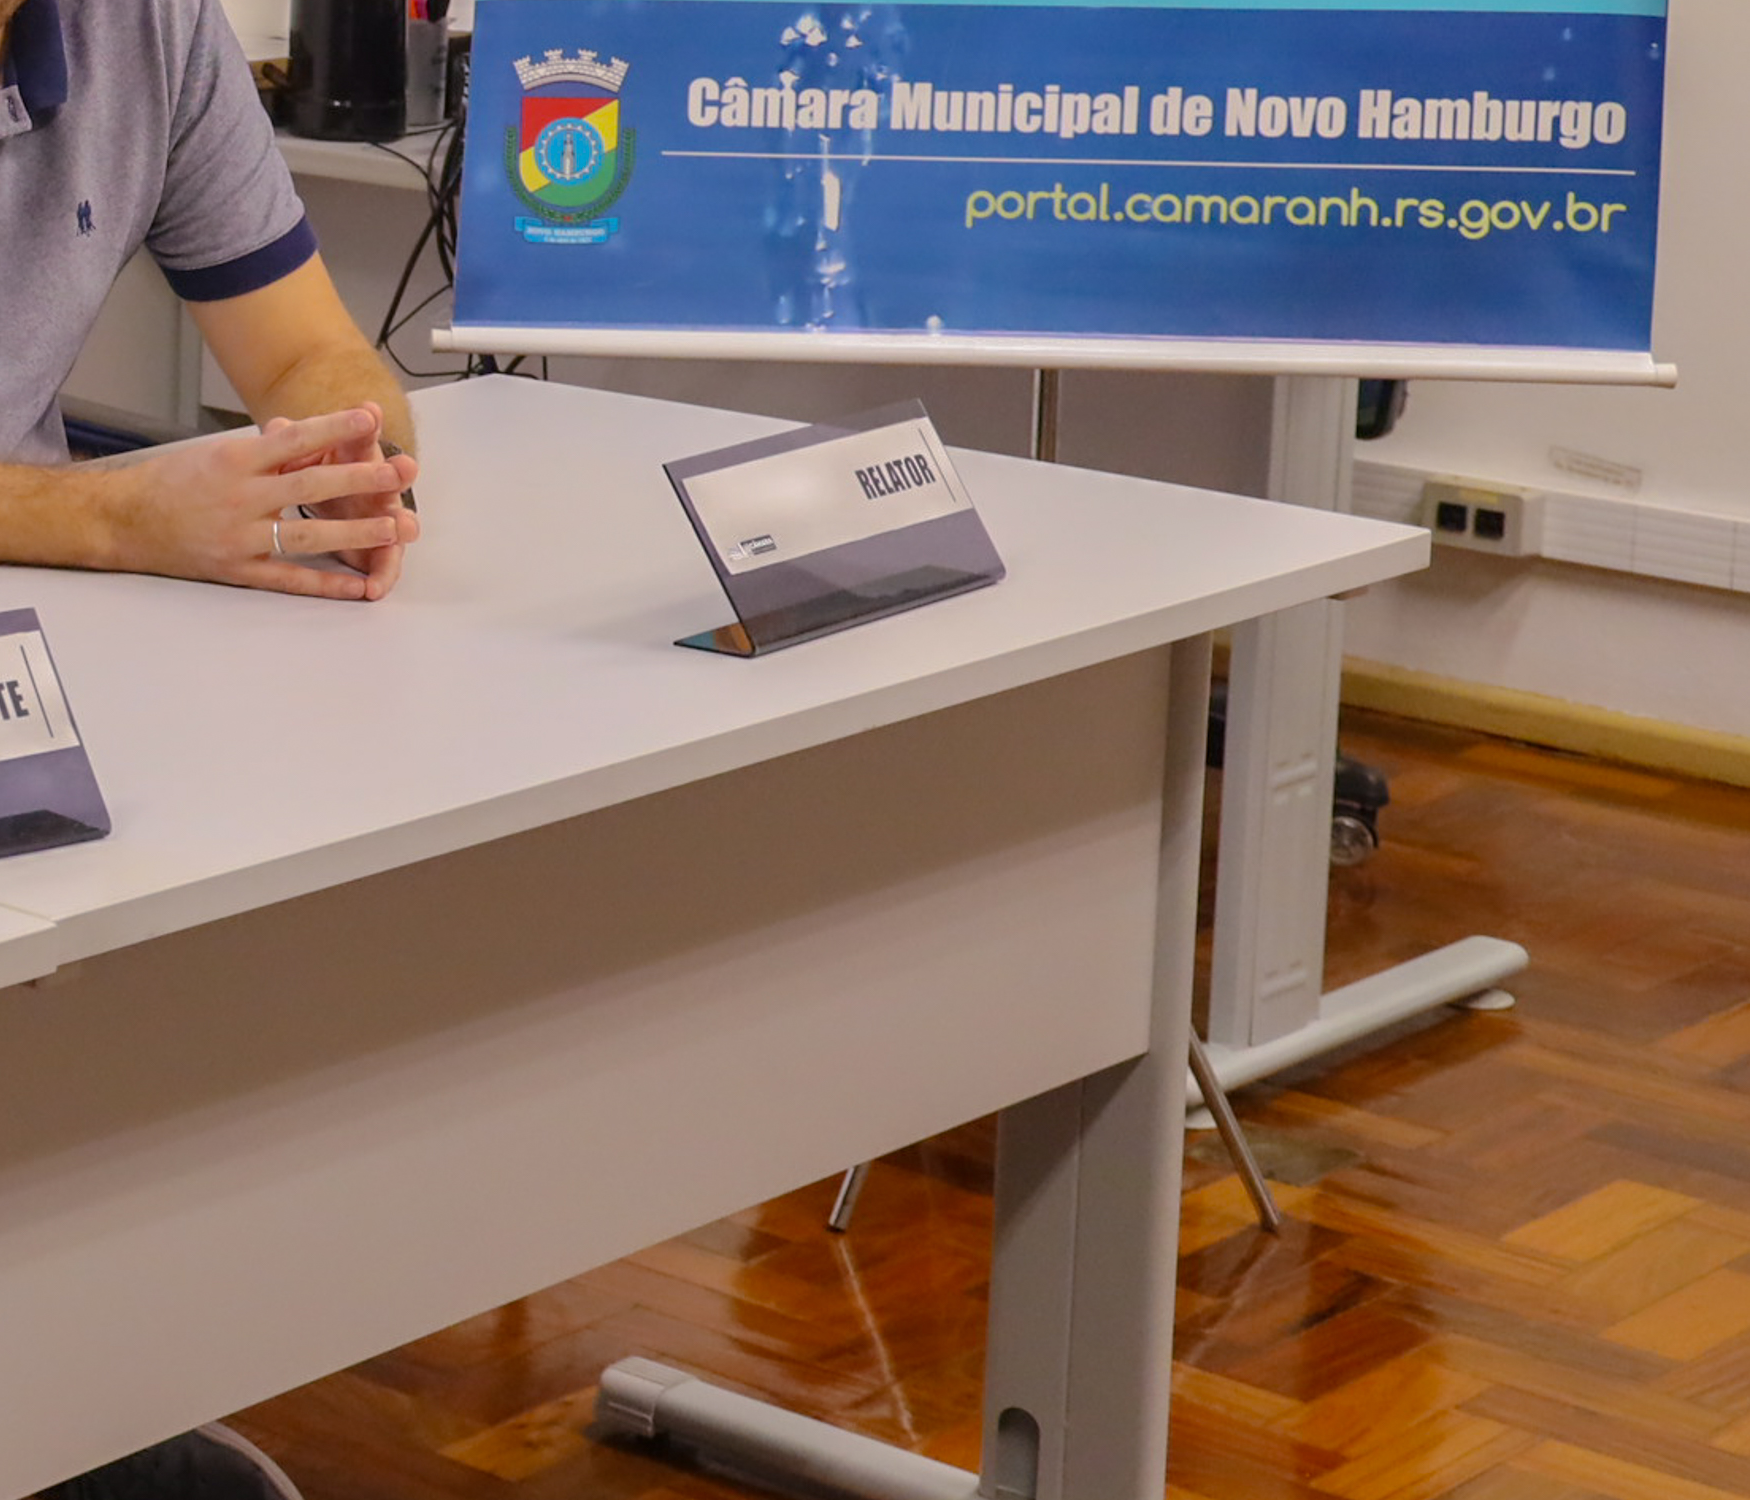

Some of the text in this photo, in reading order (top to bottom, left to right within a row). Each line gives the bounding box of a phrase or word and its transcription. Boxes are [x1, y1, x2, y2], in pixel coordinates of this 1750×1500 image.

[688, 77, 1627, 149] Câmara Municipal de Novo Hamburgo
[965, 182, 1627, 240] portal.camaranh.rs.gov.br
[854, 453, 936, 500] RELATOR
